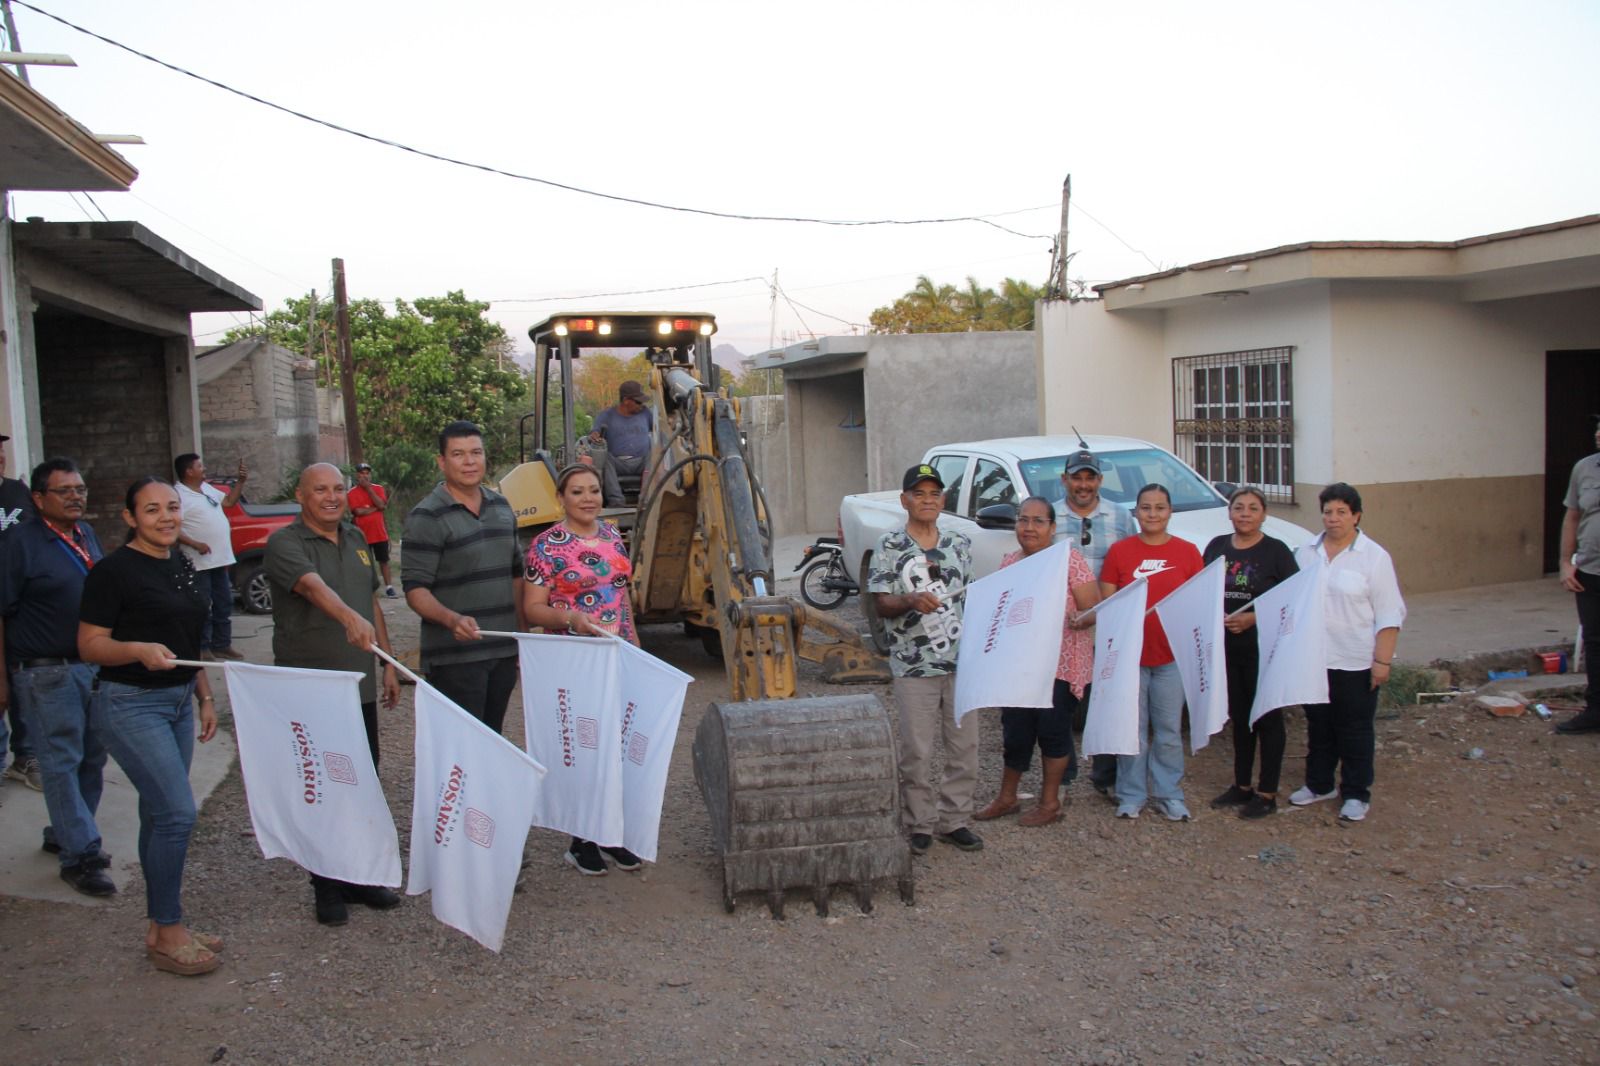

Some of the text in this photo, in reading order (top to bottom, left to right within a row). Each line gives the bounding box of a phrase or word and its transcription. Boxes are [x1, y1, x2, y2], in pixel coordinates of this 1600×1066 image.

[1140, 559, 1167, 570] NIKE
[290, 721, 315, 804] ROSARIO
[558, 688, 571, 767] ROSARIO
[435, 764, 463, 844] ROSARIO
